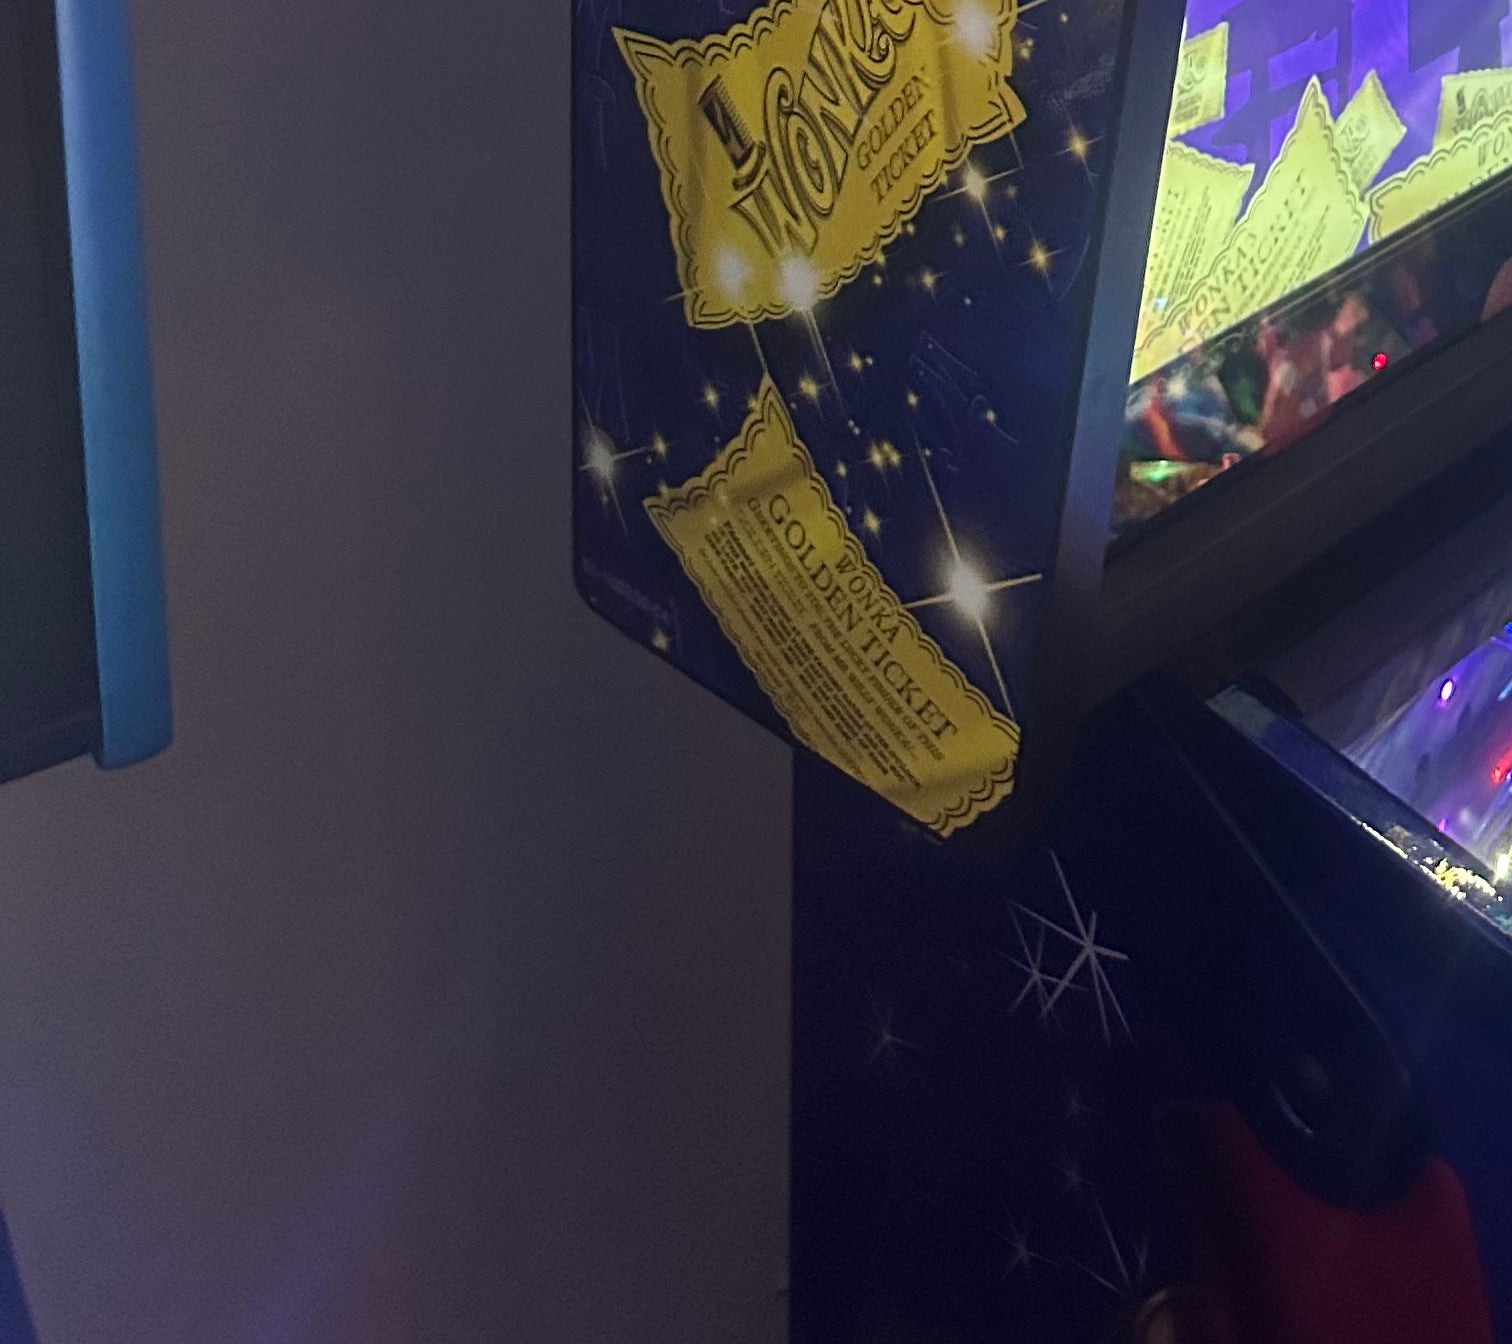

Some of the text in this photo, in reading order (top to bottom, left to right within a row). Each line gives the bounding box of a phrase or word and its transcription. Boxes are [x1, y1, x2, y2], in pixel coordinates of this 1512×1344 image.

[870, 109, 939, 205] TICKET
[768, 493, 864, 632] GOLDEN
[857, 635, 958, 736] TICKET
[835, 552, 901, 644] WONKA
